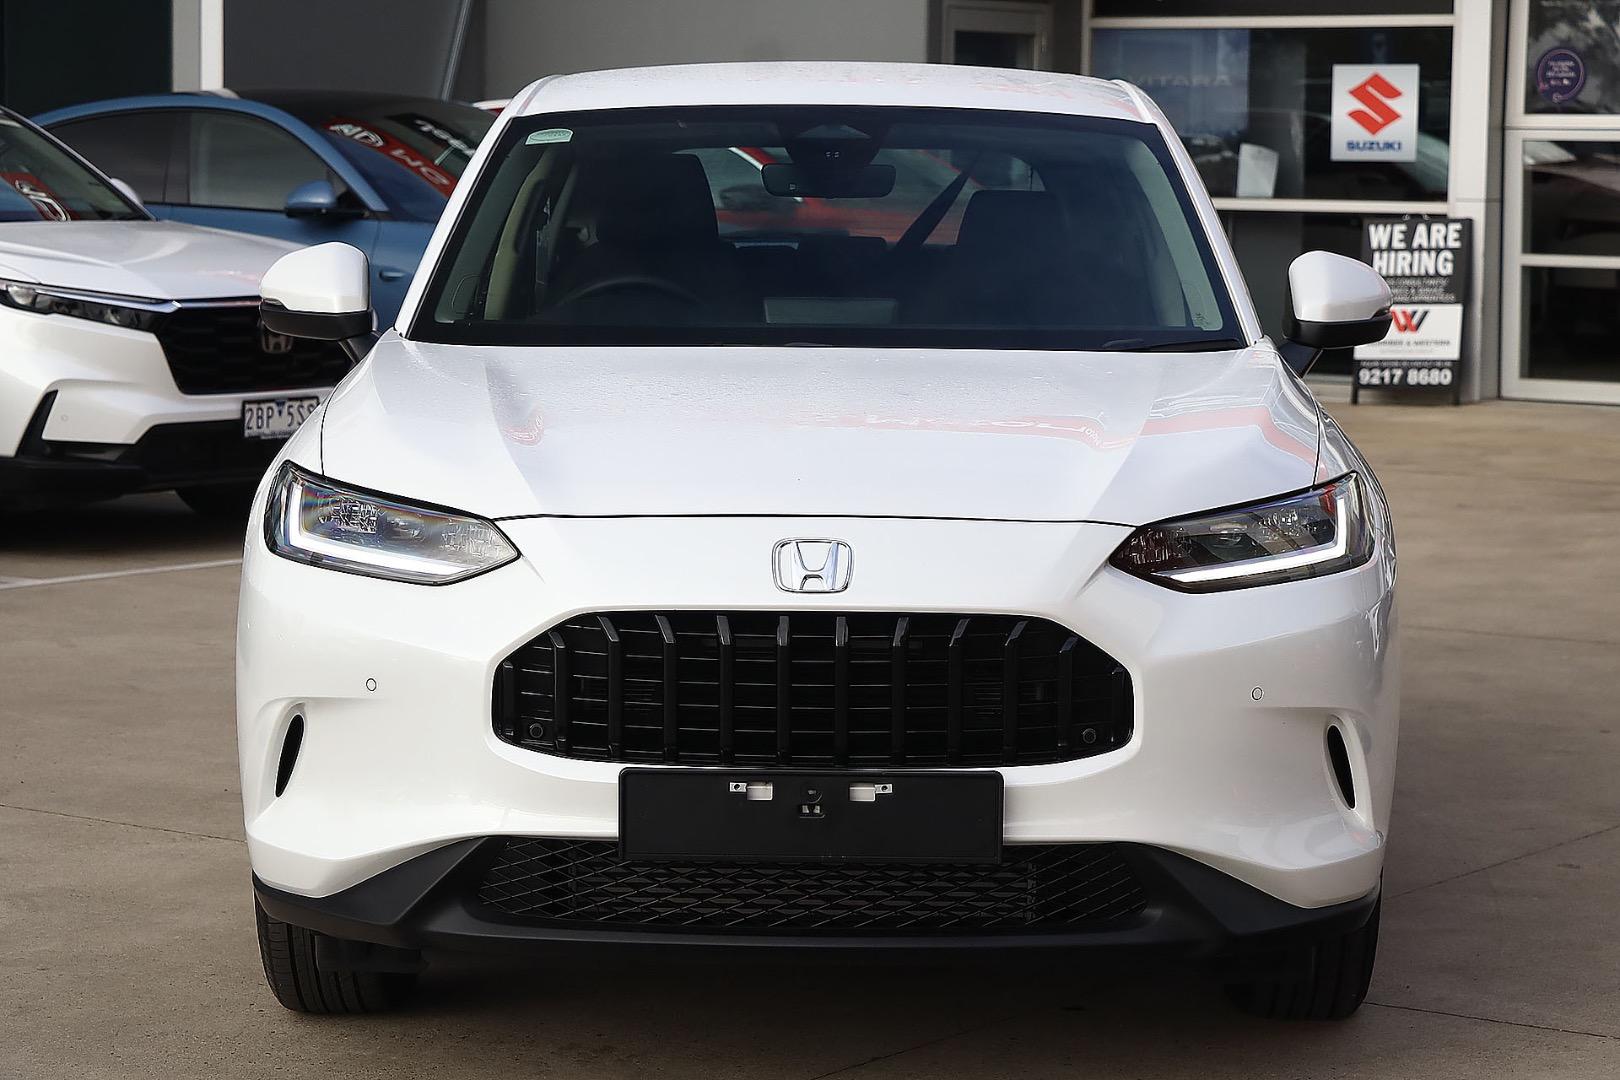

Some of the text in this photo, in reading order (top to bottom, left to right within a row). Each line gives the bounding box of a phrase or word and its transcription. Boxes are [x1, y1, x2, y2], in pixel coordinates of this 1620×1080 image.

[1346, 140, 1402, 151] SUZUKI
[1368, 222, 1462, 249] WE ARE
[1372, 249, 1454, 276] HIRING
[1358, 367, 1453, 385] 9217 8680
[245, 405, 275, 430] 2BP
